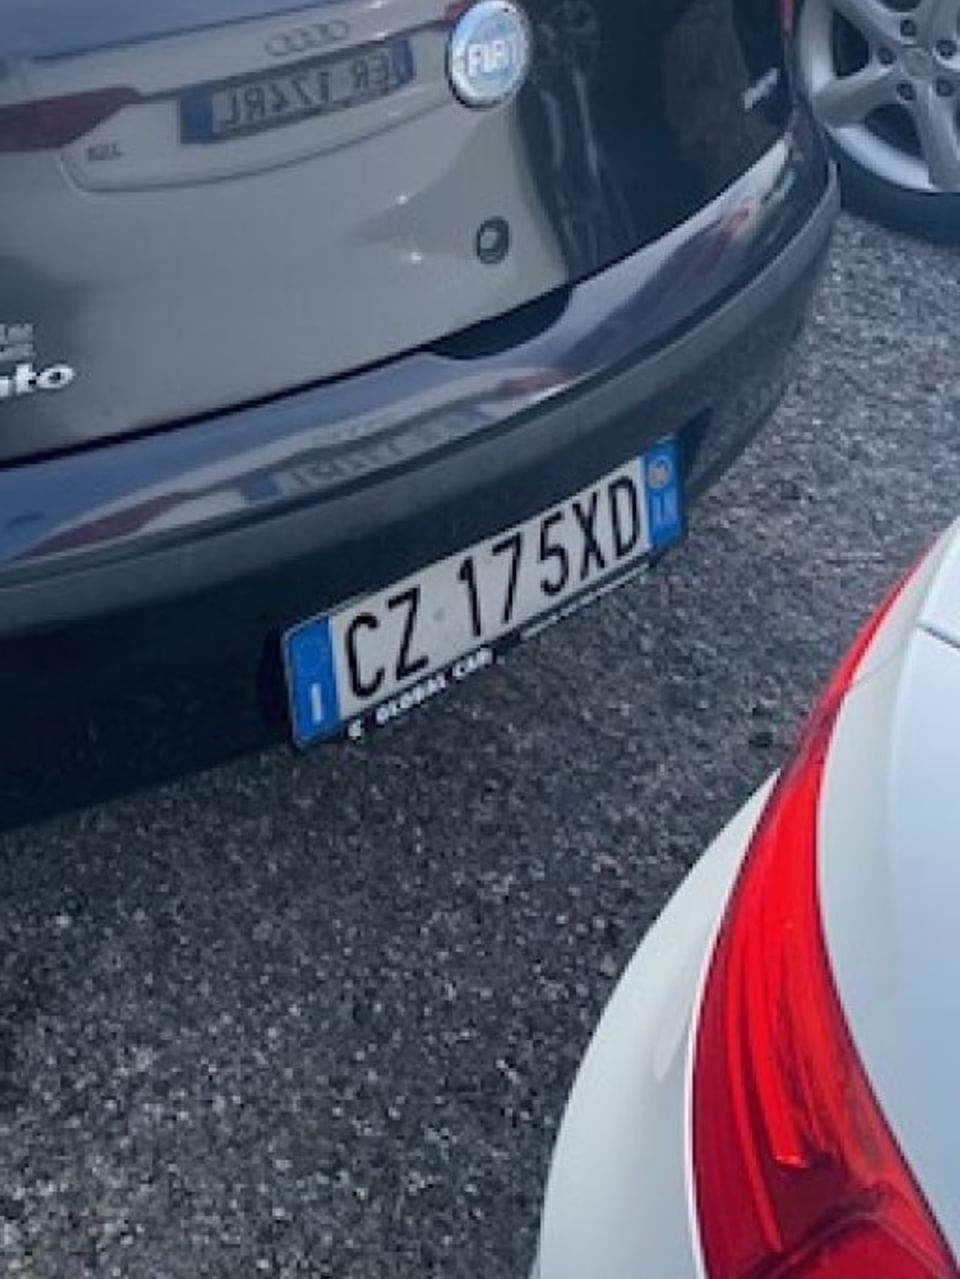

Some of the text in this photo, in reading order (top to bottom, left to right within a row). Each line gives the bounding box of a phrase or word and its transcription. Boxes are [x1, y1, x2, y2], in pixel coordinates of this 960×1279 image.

[467, 38, 522, 78] FIAT
[344, 583, 430, 699] CZ
[456, 474, 641, 638] 175XD
